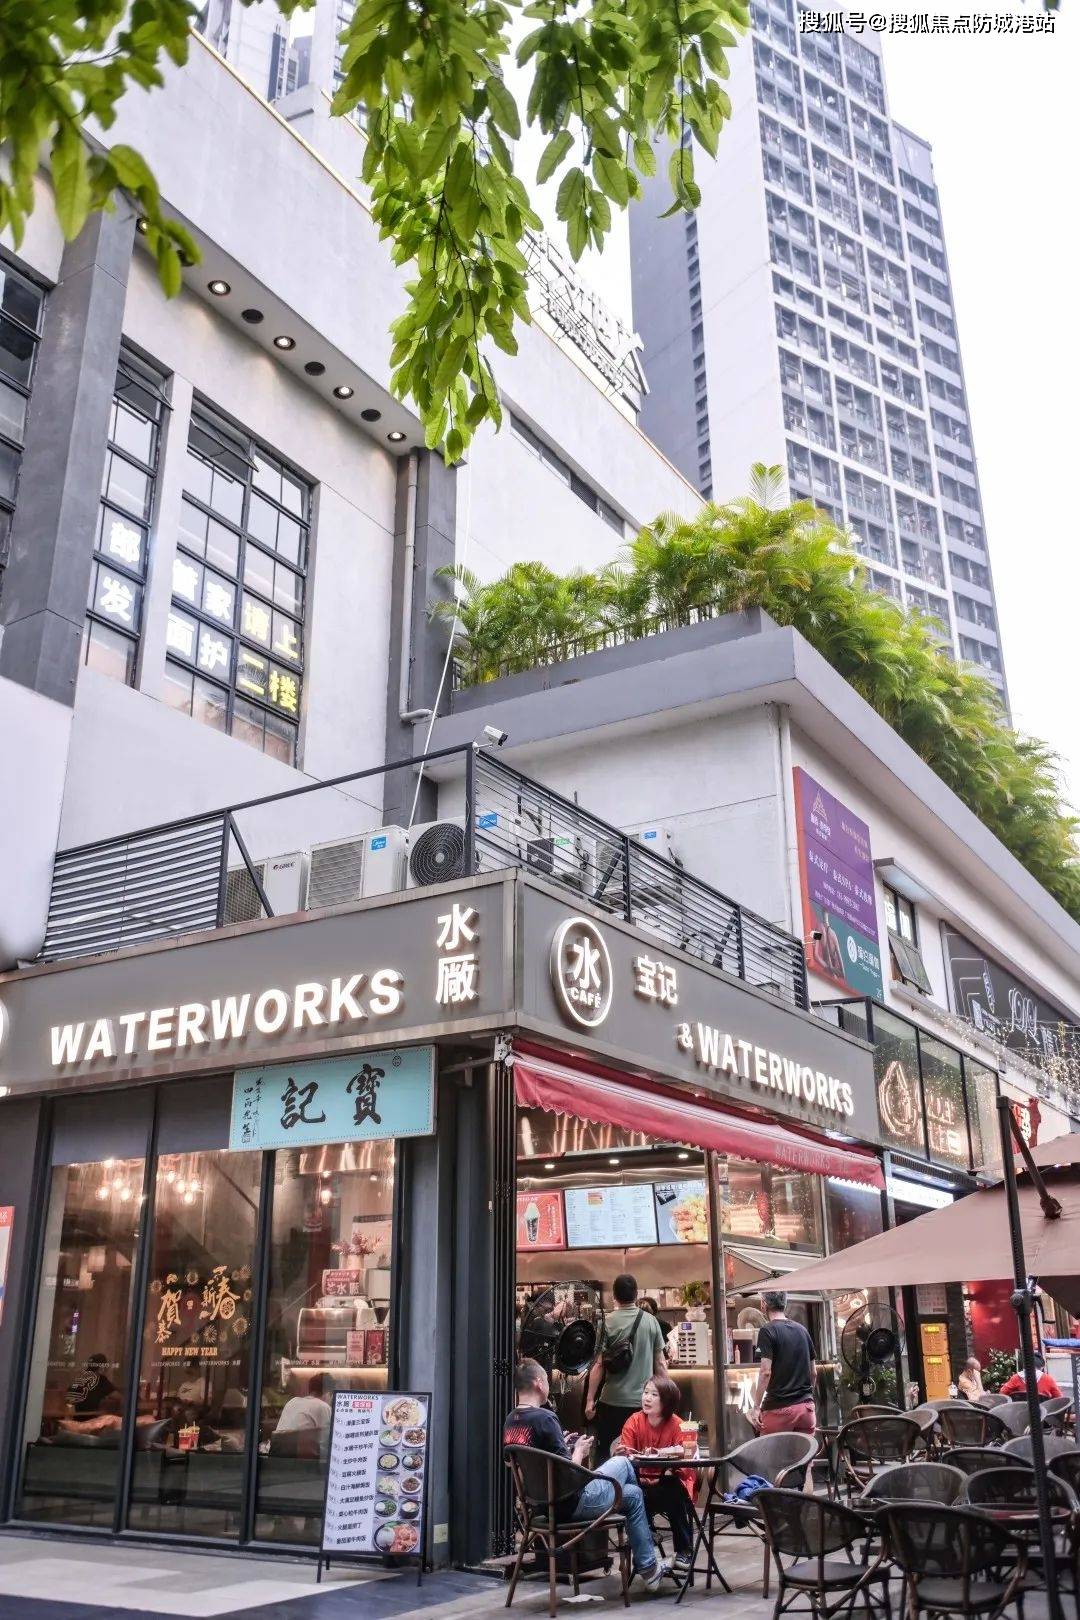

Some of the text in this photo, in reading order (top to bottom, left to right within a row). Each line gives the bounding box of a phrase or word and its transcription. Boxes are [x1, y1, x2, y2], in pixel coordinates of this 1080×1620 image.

[573, 936, 601, 989] 水
[636, 954, 679, 1005] 宝记
[49, 967, 403, 1066] WATERWORKS
[697, 1021, 855, 1117] WATERWORKS
[161, 1346, 218, 1356] HAPPY NEW YEAR
[336, 1393, 379, 1401] WATERWORKS
